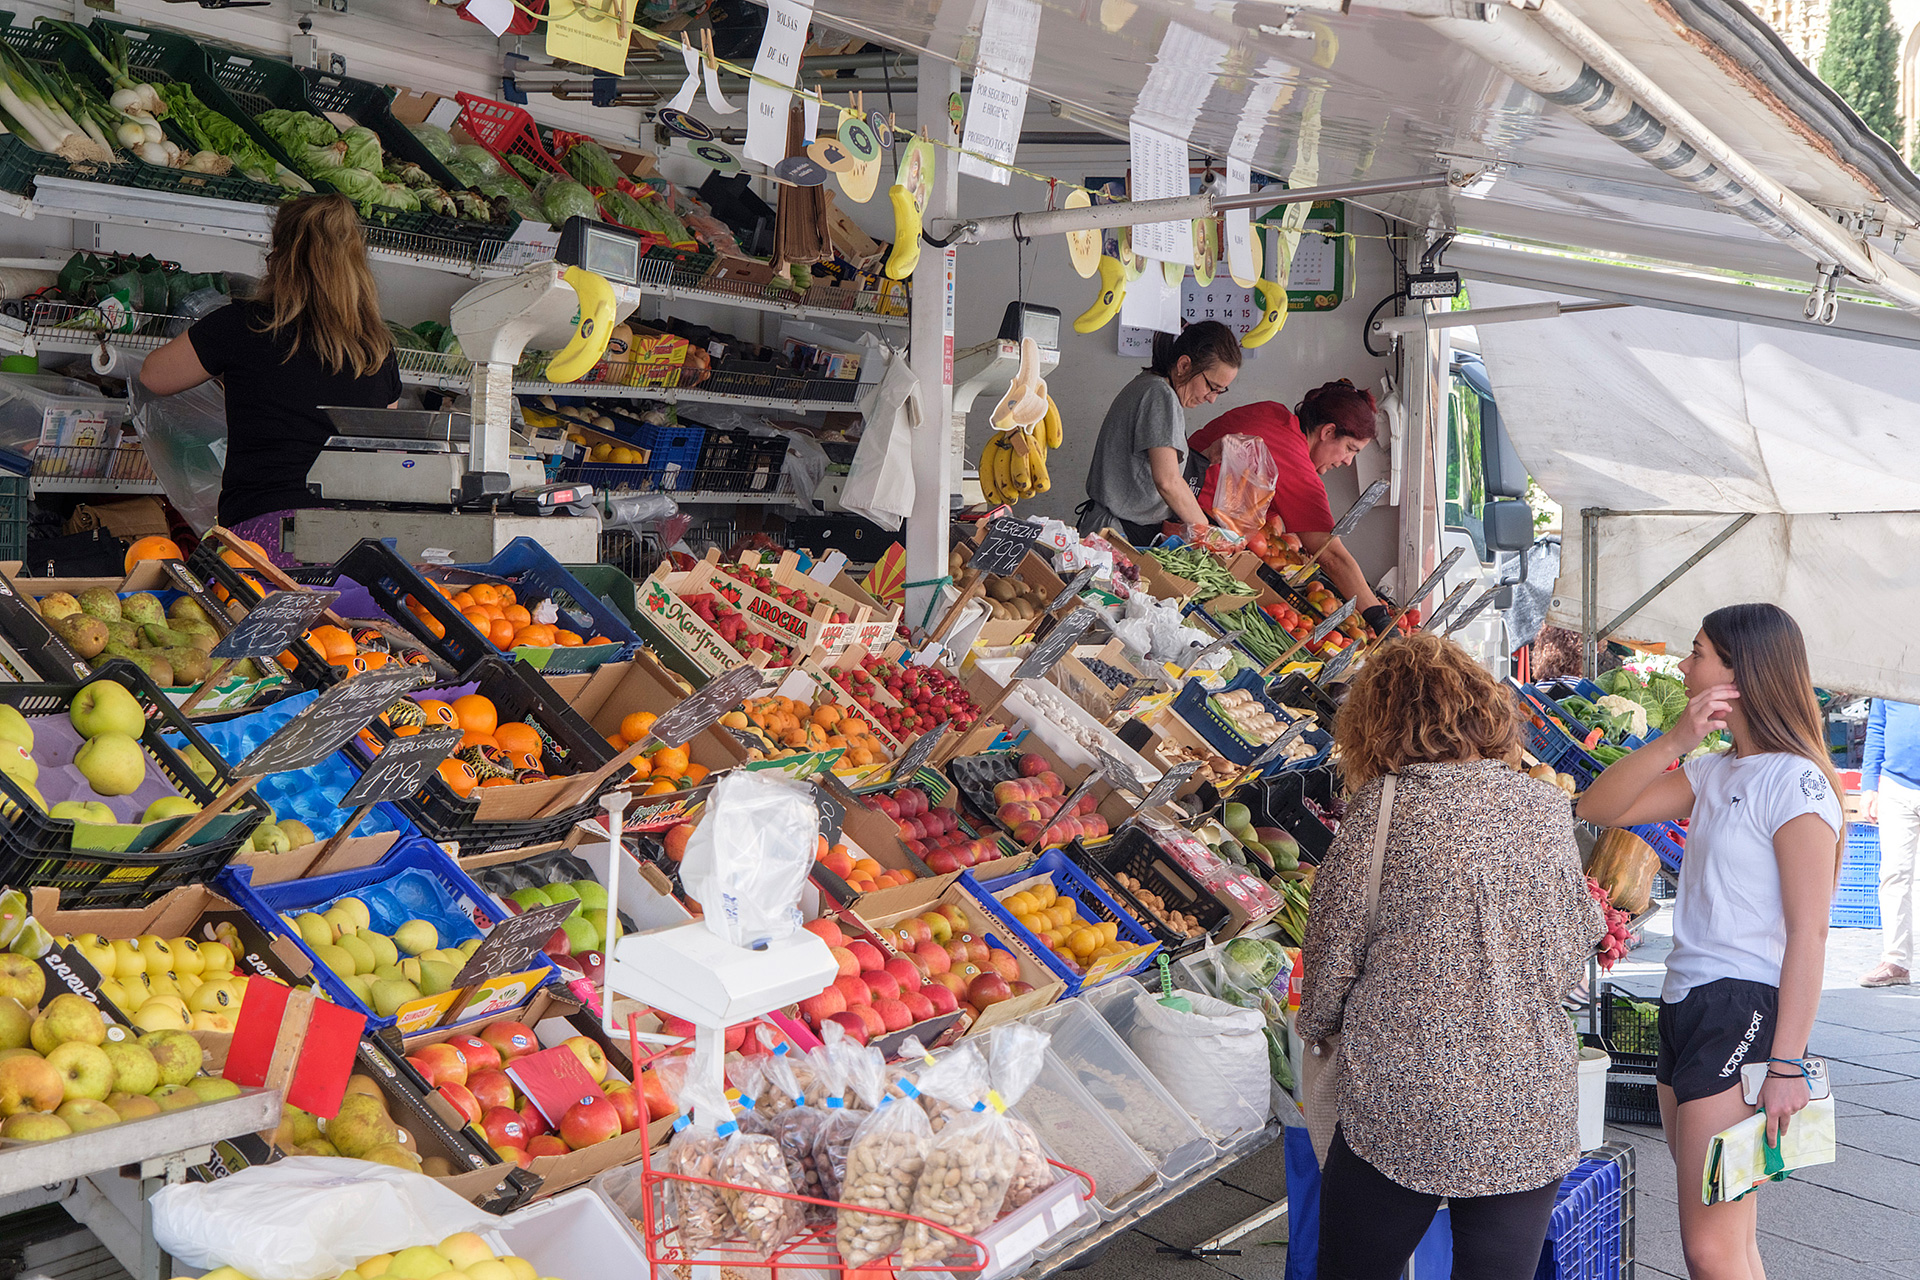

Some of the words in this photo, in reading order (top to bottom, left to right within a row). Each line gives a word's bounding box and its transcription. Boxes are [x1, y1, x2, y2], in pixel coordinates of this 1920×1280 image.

[776, 10, 798, 32] BOLSAS
[767, 46, 777, 61] DE
[777, 52, 790, 67] ASA
[976, 83, 989, 96] POR
[989, 87, 1019, 107] SEGURIDAD
[987, 104, 1010, 120] HIGIENE
[966, 130, 994, 148] PROHIBIDO
[1311, 200, 1332, 209] ESPRI
[1188, 294, 1194, 302] 5
[1207, 294, 1213, 302] 6
[1225, 294, 1232, 302] 7
[1244, 294, 1250, 303] 8
[1186, 308, 1196, 317] 12
[1205, 309, 1214, 318] 13
[1223, 309, 1233, 318] 14
[1242, 309, 1250, 318] 15
[1239, 324, 1250, 333] 22
[995, 518, 1040, 540] CEREZAS
[746, 595, 809, 641] AROCHA
[665, 599, 739, 669] Marifranc
[819, 625, 844, 640] AROCHA
[859, 624, 883, 639] AROCHA
[337, 676, 416, 703] MANZANAS
[312, 695, 395, 721] GOLDEN
[503, 911, 556, 936] PERAS
[978, 904, 1012, 936] GIRONA
[1010, 933, 1046, 968] FRUITS
[401, 1006, 435, 1024] SUNGOLD
[479, 998, 514, 1016] Zespri
[1718, 1040, 1752, 1078] VICTORIA
[1744, 1009, 1764, 1043] SPORT
